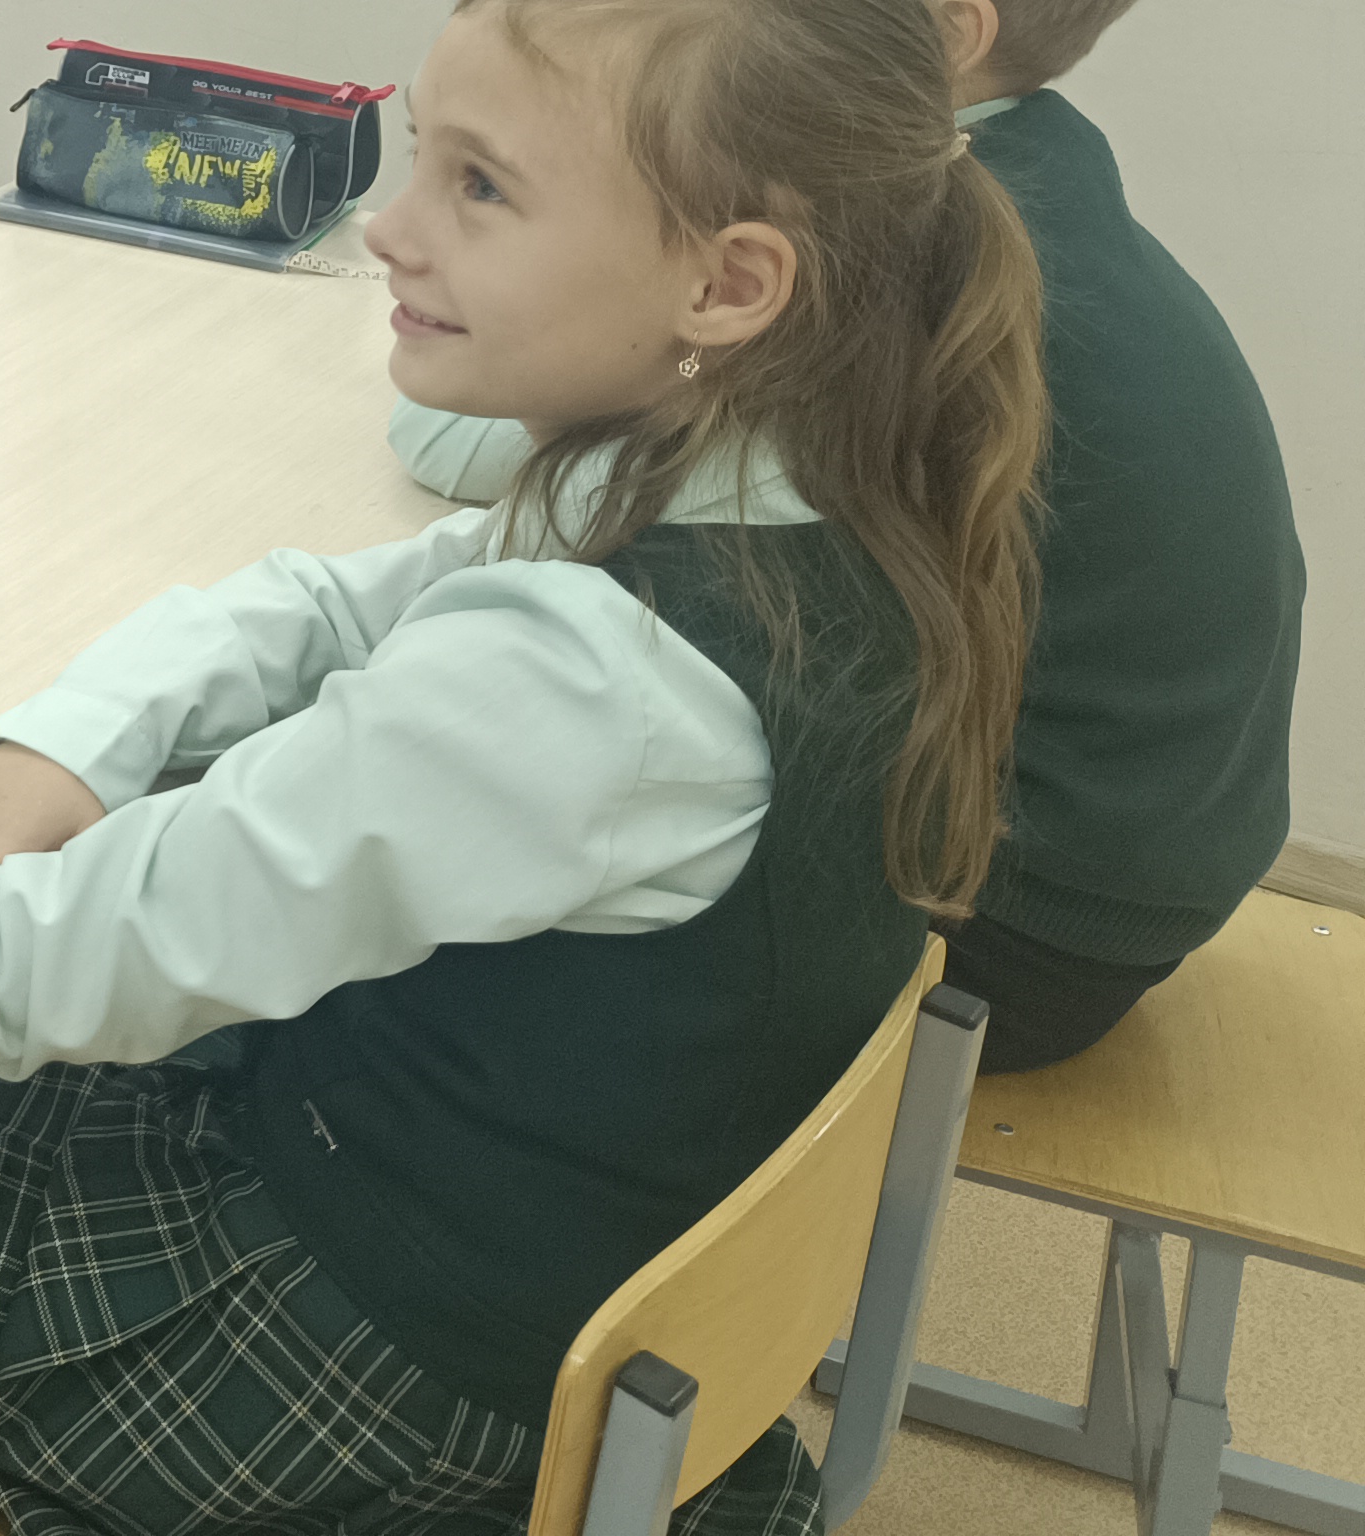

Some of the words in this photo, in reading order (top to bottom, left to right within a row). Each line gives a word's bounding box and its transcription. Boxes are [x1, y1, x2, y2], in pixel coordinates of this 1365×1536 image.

[192, 79, 208, 89] DO
[211, 83, 242, 95] YOUR
[245, 89, 273, 100] BEST
[180, 131, 217, 152] MEET
[217, 136, 243, 155] ME
